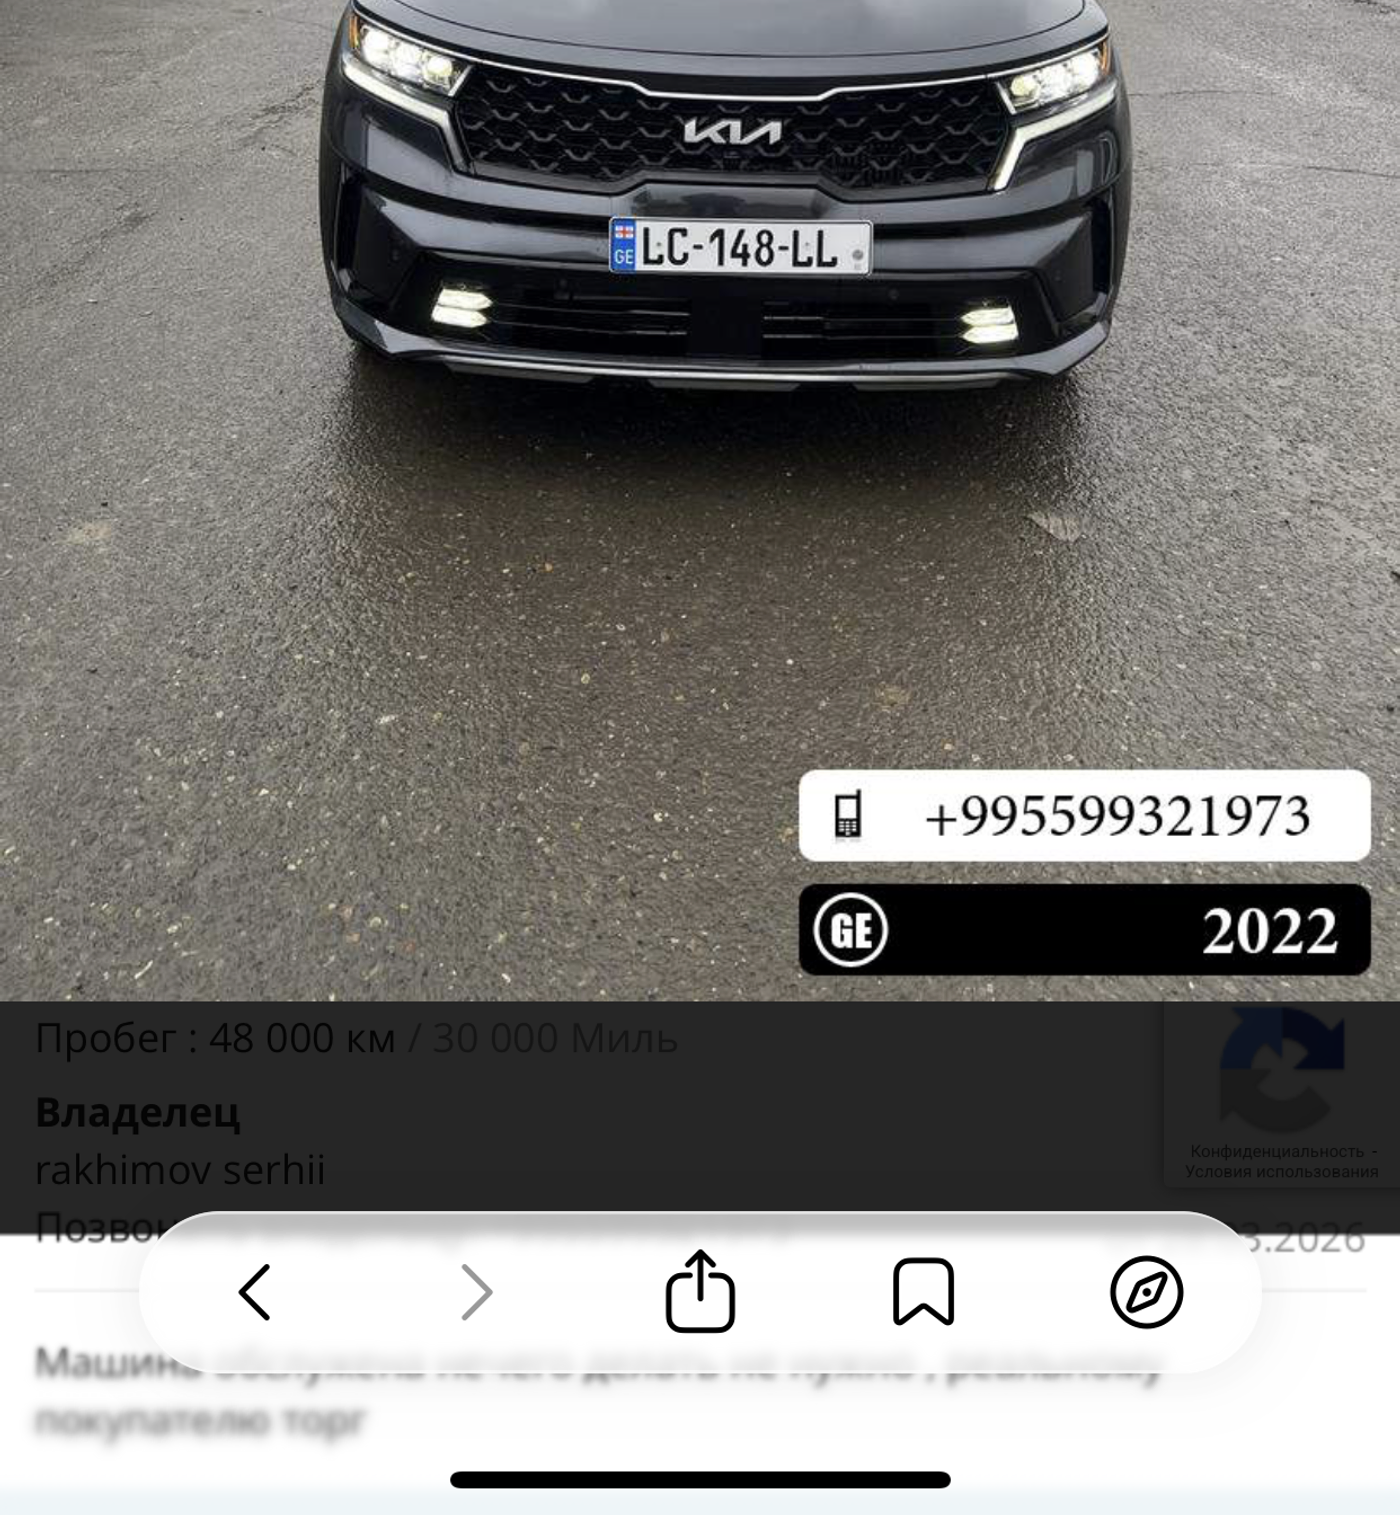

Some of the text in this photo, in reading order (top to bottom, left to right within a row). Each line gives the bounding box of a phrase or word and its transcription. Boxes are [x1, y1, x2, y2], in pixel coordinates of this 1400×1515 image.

[684, 118, 782, 145] KIA
[615, 249, 634, 264] GE
[642, 227, 838, 268] LC-148-LL
[36, 1021, 177, 1063] Пробег
[209, 1022, 254, 1053] 48
[267, 1022, 334, 1053] 000
[348, 1029, 395, 1053] км
[433, 1022, 478, 1054] 30
[491, 1022, 558, 1054] 000
[573, 1022, 679, 1053] Миль
[36, 1097, 241, 1135] Владелец
[1191, 1144, 1365, 1160] Конфиденциальность
[36, 1153, 325, 1185] rakhimov serhii
[1185, 1164, 1379, 1178] Условия использования
[1230, 1221, 1366, 1253] 3.2026
